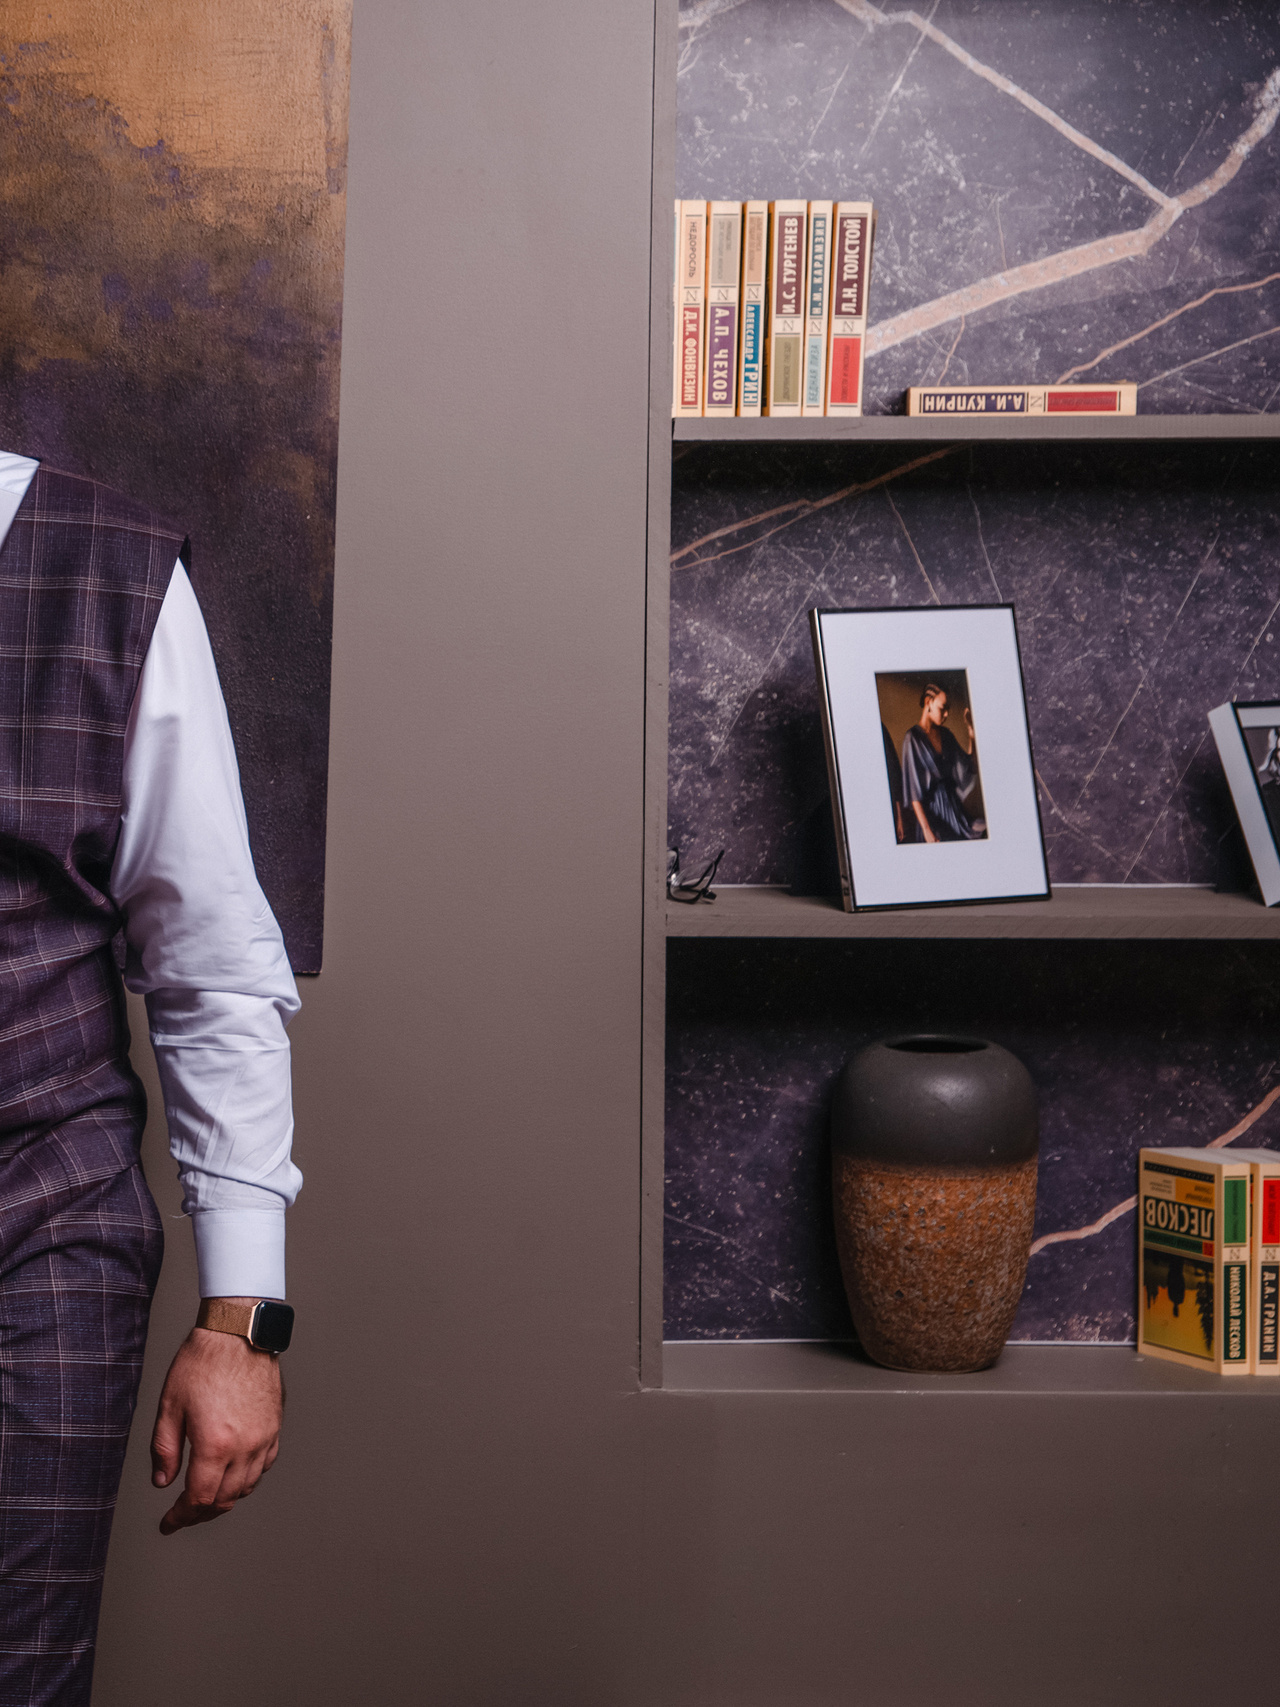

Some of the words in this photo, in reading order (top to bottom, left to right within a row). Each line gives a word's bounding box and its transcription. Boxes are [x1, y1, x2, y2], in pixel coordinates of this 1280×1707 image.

[688, 221, 698, 278] НЕДОРОСЛЬ
[783, 217, 798, 285] ТУРГЕНЕВ
[813, 220, 825, 284] КАРАМЗИН
[843, 218, 861, 281] ТОЛСТОЙ
[782, 286, 797, 314] И.С.
[841, 283, 858, 314] Л.Н.
[683, 310, 698, 336] Д.И.
[714, 307, 730, 343] А.П.
[745, 305, 755, 360] АЛЕКСАНДР
[683, 337, 698, 402] ФОНВИЗИН
[712, 349, 729, 401] ЧЕХОВ
[810, 344, 820, 367] ЛИЗА
[743, 363, 759, 403] ГРИН
[808, 369, 819, 402] БЕДНАЯ
[925, 395, 986, 411] КУПРИН
[990, 394, 1023, 411] А.И.
[1145, 1198, 1214, 1239] ЛЕСКОВ
[1229, 1266, 1242, 1317] НИКОЛАЙ
[1263, 1271, 1276, 1299] Д.А.
[1229, 1318, 1241, 1359] ЛЕСКОВ
[1263, 1303, 1276, 1353] ГРАНИН
